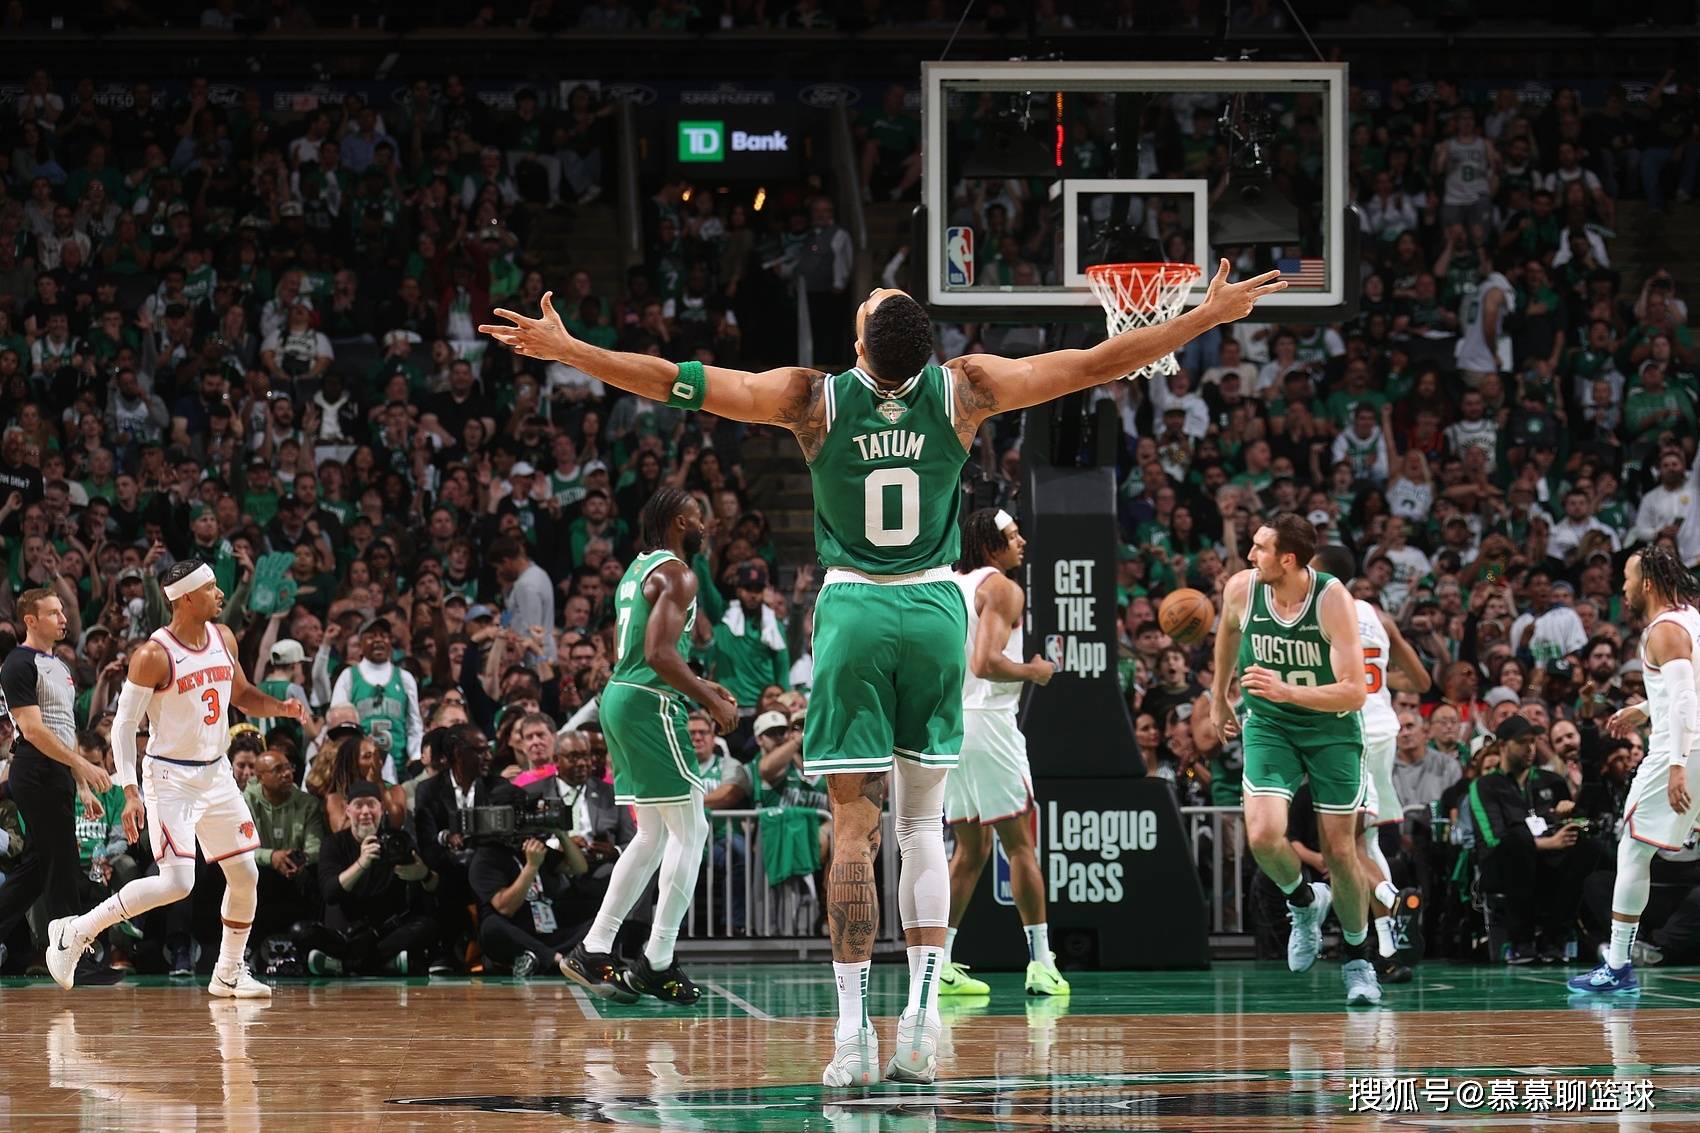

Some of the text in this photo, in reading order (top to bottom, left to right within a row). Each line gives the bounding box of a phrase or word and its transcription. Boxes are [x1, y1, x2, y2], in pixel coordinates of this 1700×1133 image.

[683, 128, 788, 154] TD Bank
[672, 381, 695, 400] 0
[853, 430, 926, 461] TATUM
[864, 467, 920, 547] 0
[1054, 560, 1096, 595] GET
[1054, 597, 1097, 632] THE
[617, 606, 633, 660] 7
[1065, 634, 1107, 679] App
[1251, 634, 1323, 668] BOSTON
[176, 665, 232, 695] NEW YORK
[1363, 647, 1382, 695] 5
[201, 688, 220, 726] 3
[1048, 801, 1158, 861] League
[841, 863, 869, 882] JUST
[1048, 853, 1124, 903] Pass
